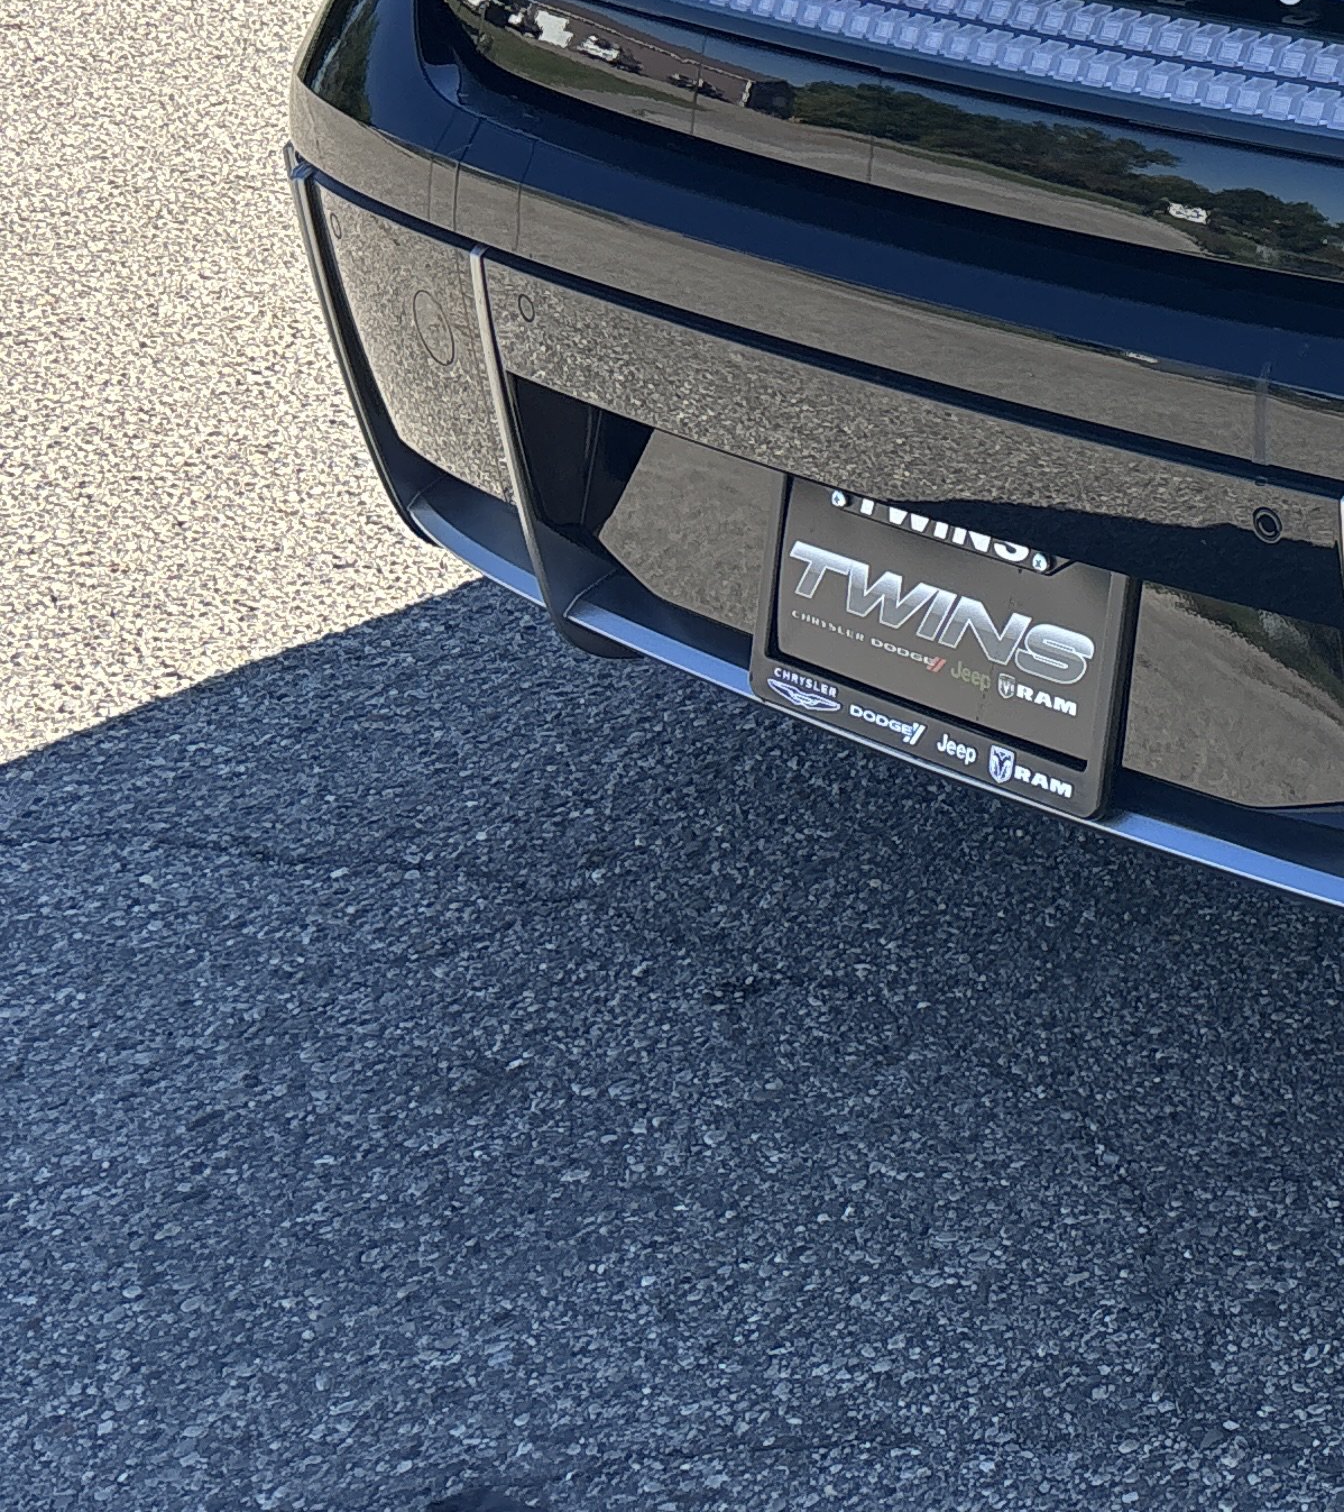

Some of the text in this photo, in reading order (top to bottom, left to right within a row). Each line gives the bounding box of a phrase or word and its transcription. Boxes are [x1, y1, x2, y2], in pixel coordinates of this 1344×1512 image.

[789, 540, 1095, 685] TWINS
[791, 609, 1077, 718] CHRYSLER DODGE Jeep RAM
[773, 667, 839, 698] CHRYSLER
[848, 704, 1074, 799] DODGE Jeep RAM
